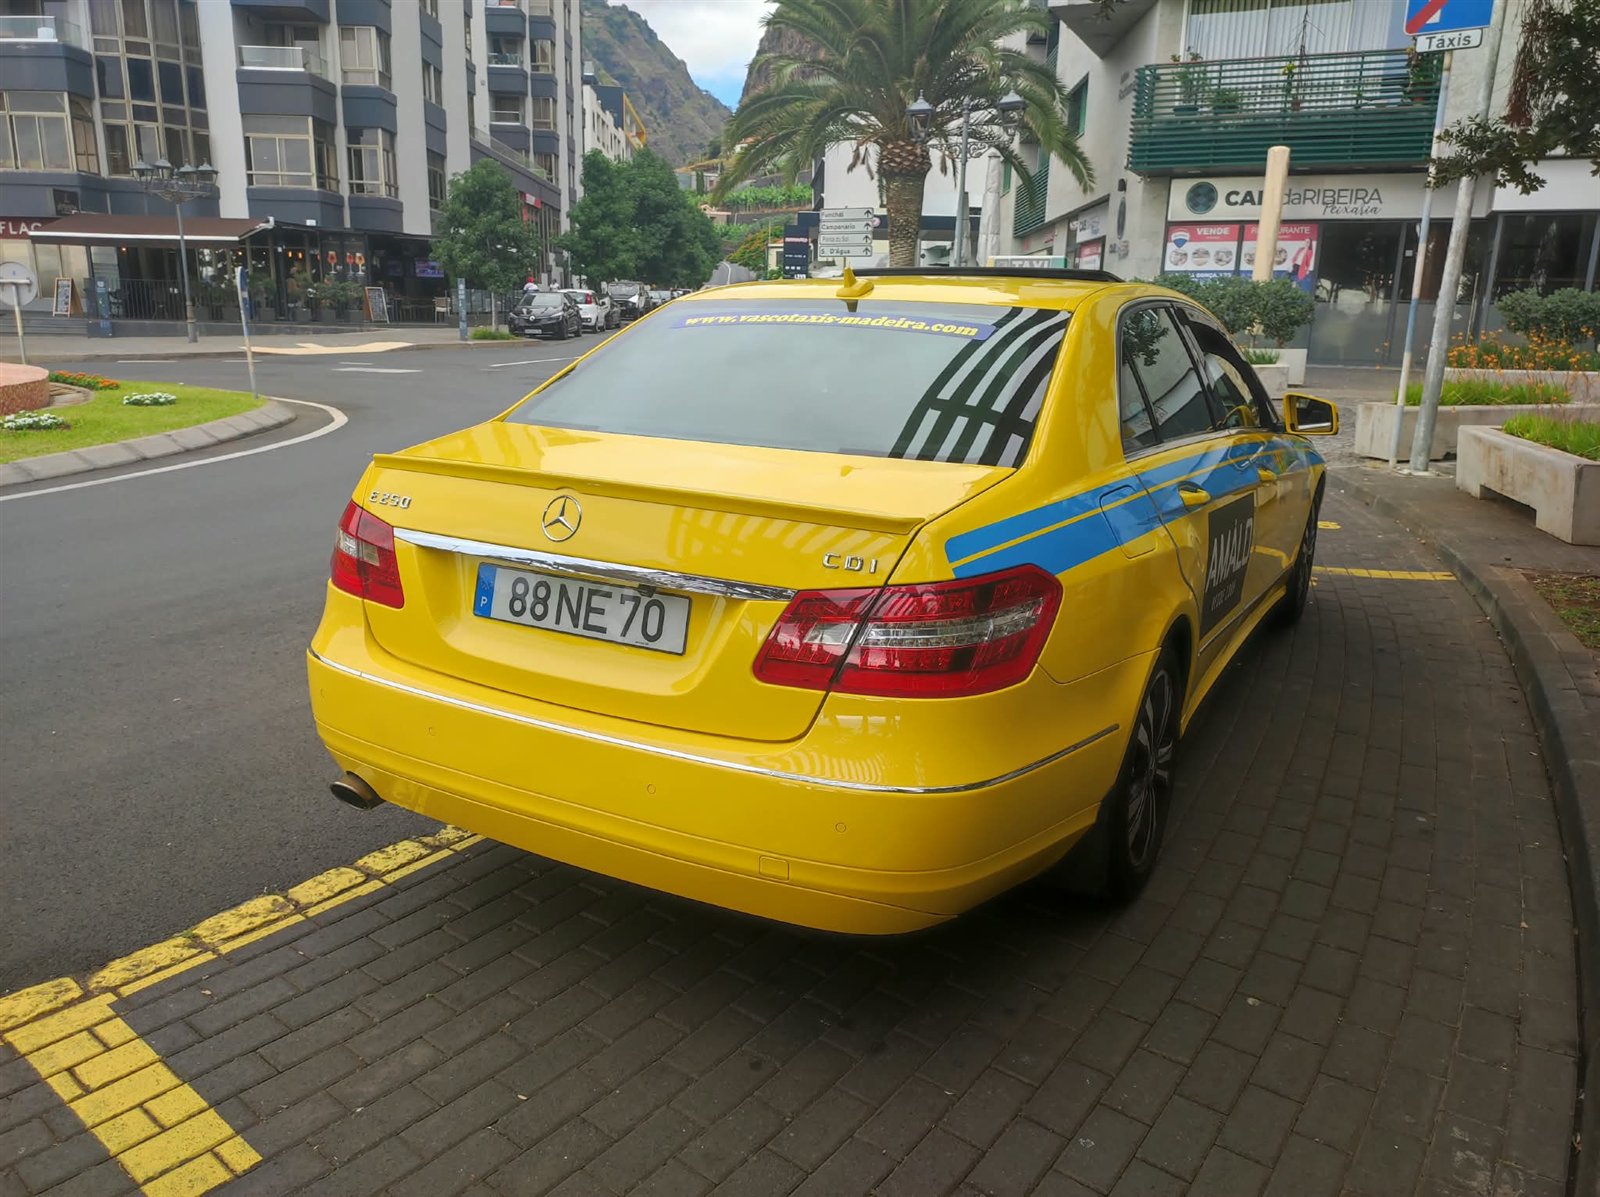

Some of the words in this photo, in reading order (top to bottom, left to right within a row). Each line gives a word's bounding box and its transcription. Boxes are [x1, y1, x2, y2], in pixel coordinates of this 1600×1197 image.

[1425, 33, 1471, 50] Táxis
[1225, 190, 1263, 206] CAI
[1196, 227, 1231, 236] VENDE
[685, 313, 979, 337] www.vascotaxis-madeira.com
[822, 552, 878, 575] CDI
[479, 595, 489, 608] P
